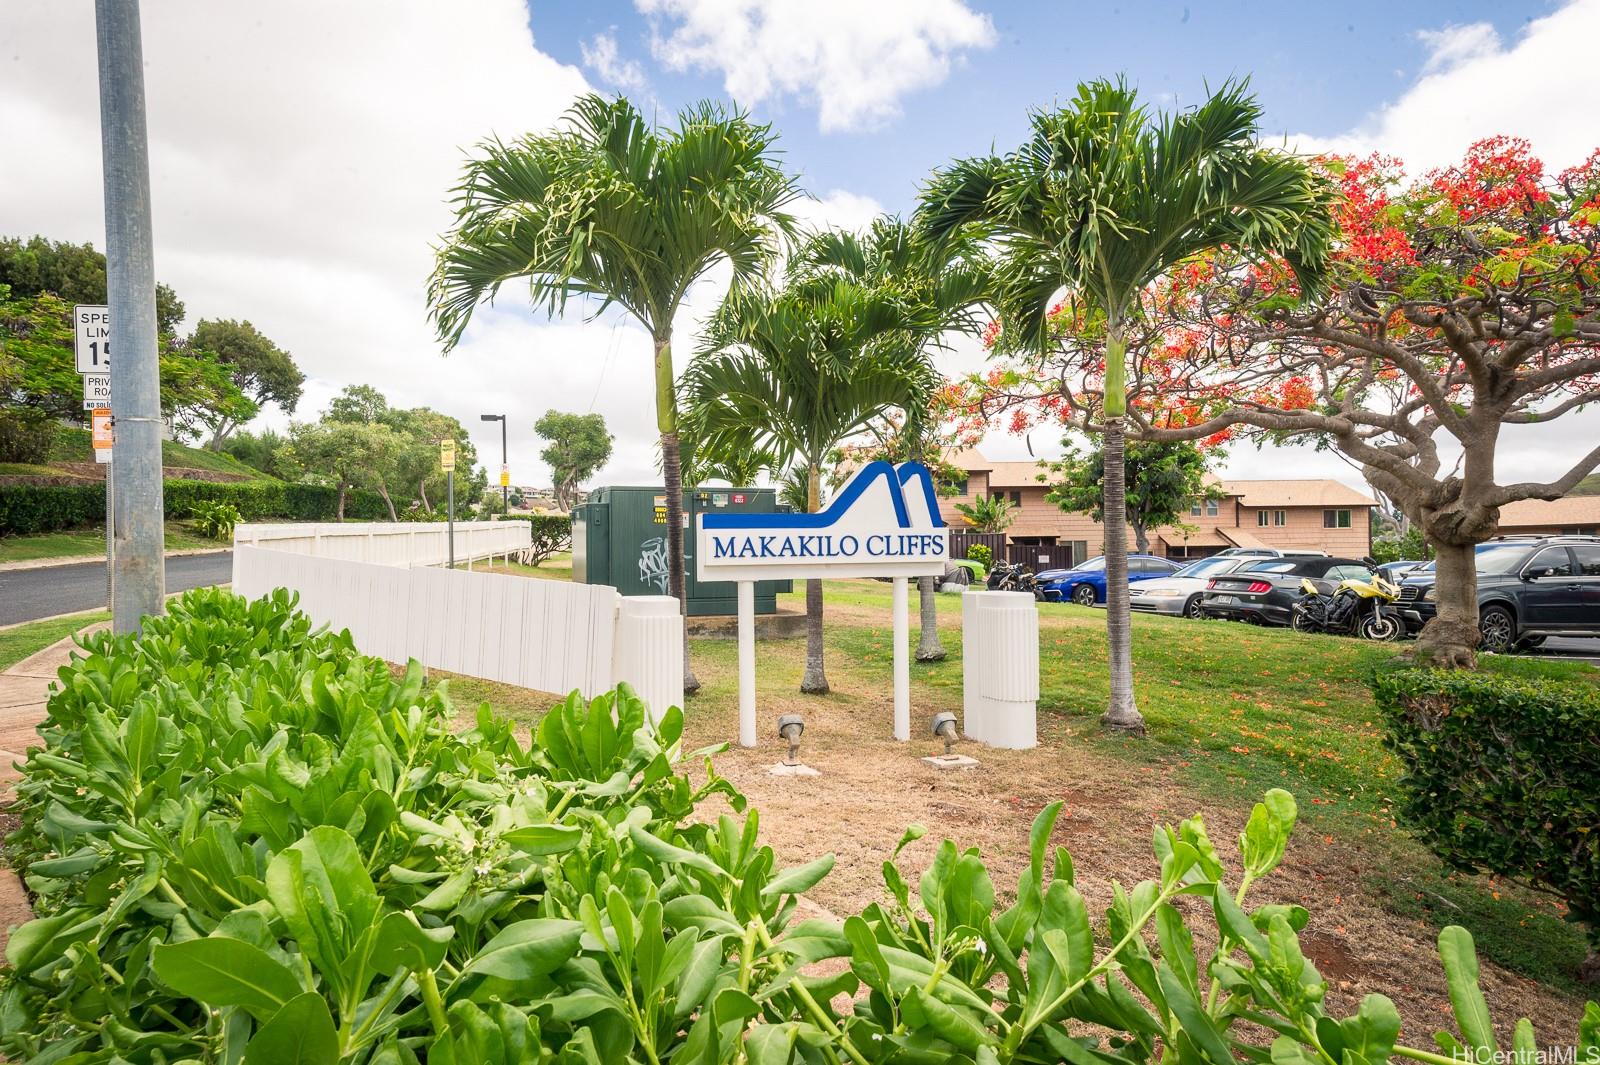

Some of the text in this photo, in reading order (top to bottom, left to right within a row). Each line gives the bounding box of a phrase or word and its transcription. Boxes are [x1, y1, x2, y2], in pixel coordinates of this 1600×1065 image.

[81, 313, 109, 324] SPE
[86, 327, 109, 338] LIM
[88, 377, 110, 386] PRIV
[713, 534, 944, 558] MAKAKILO CLIFFS
